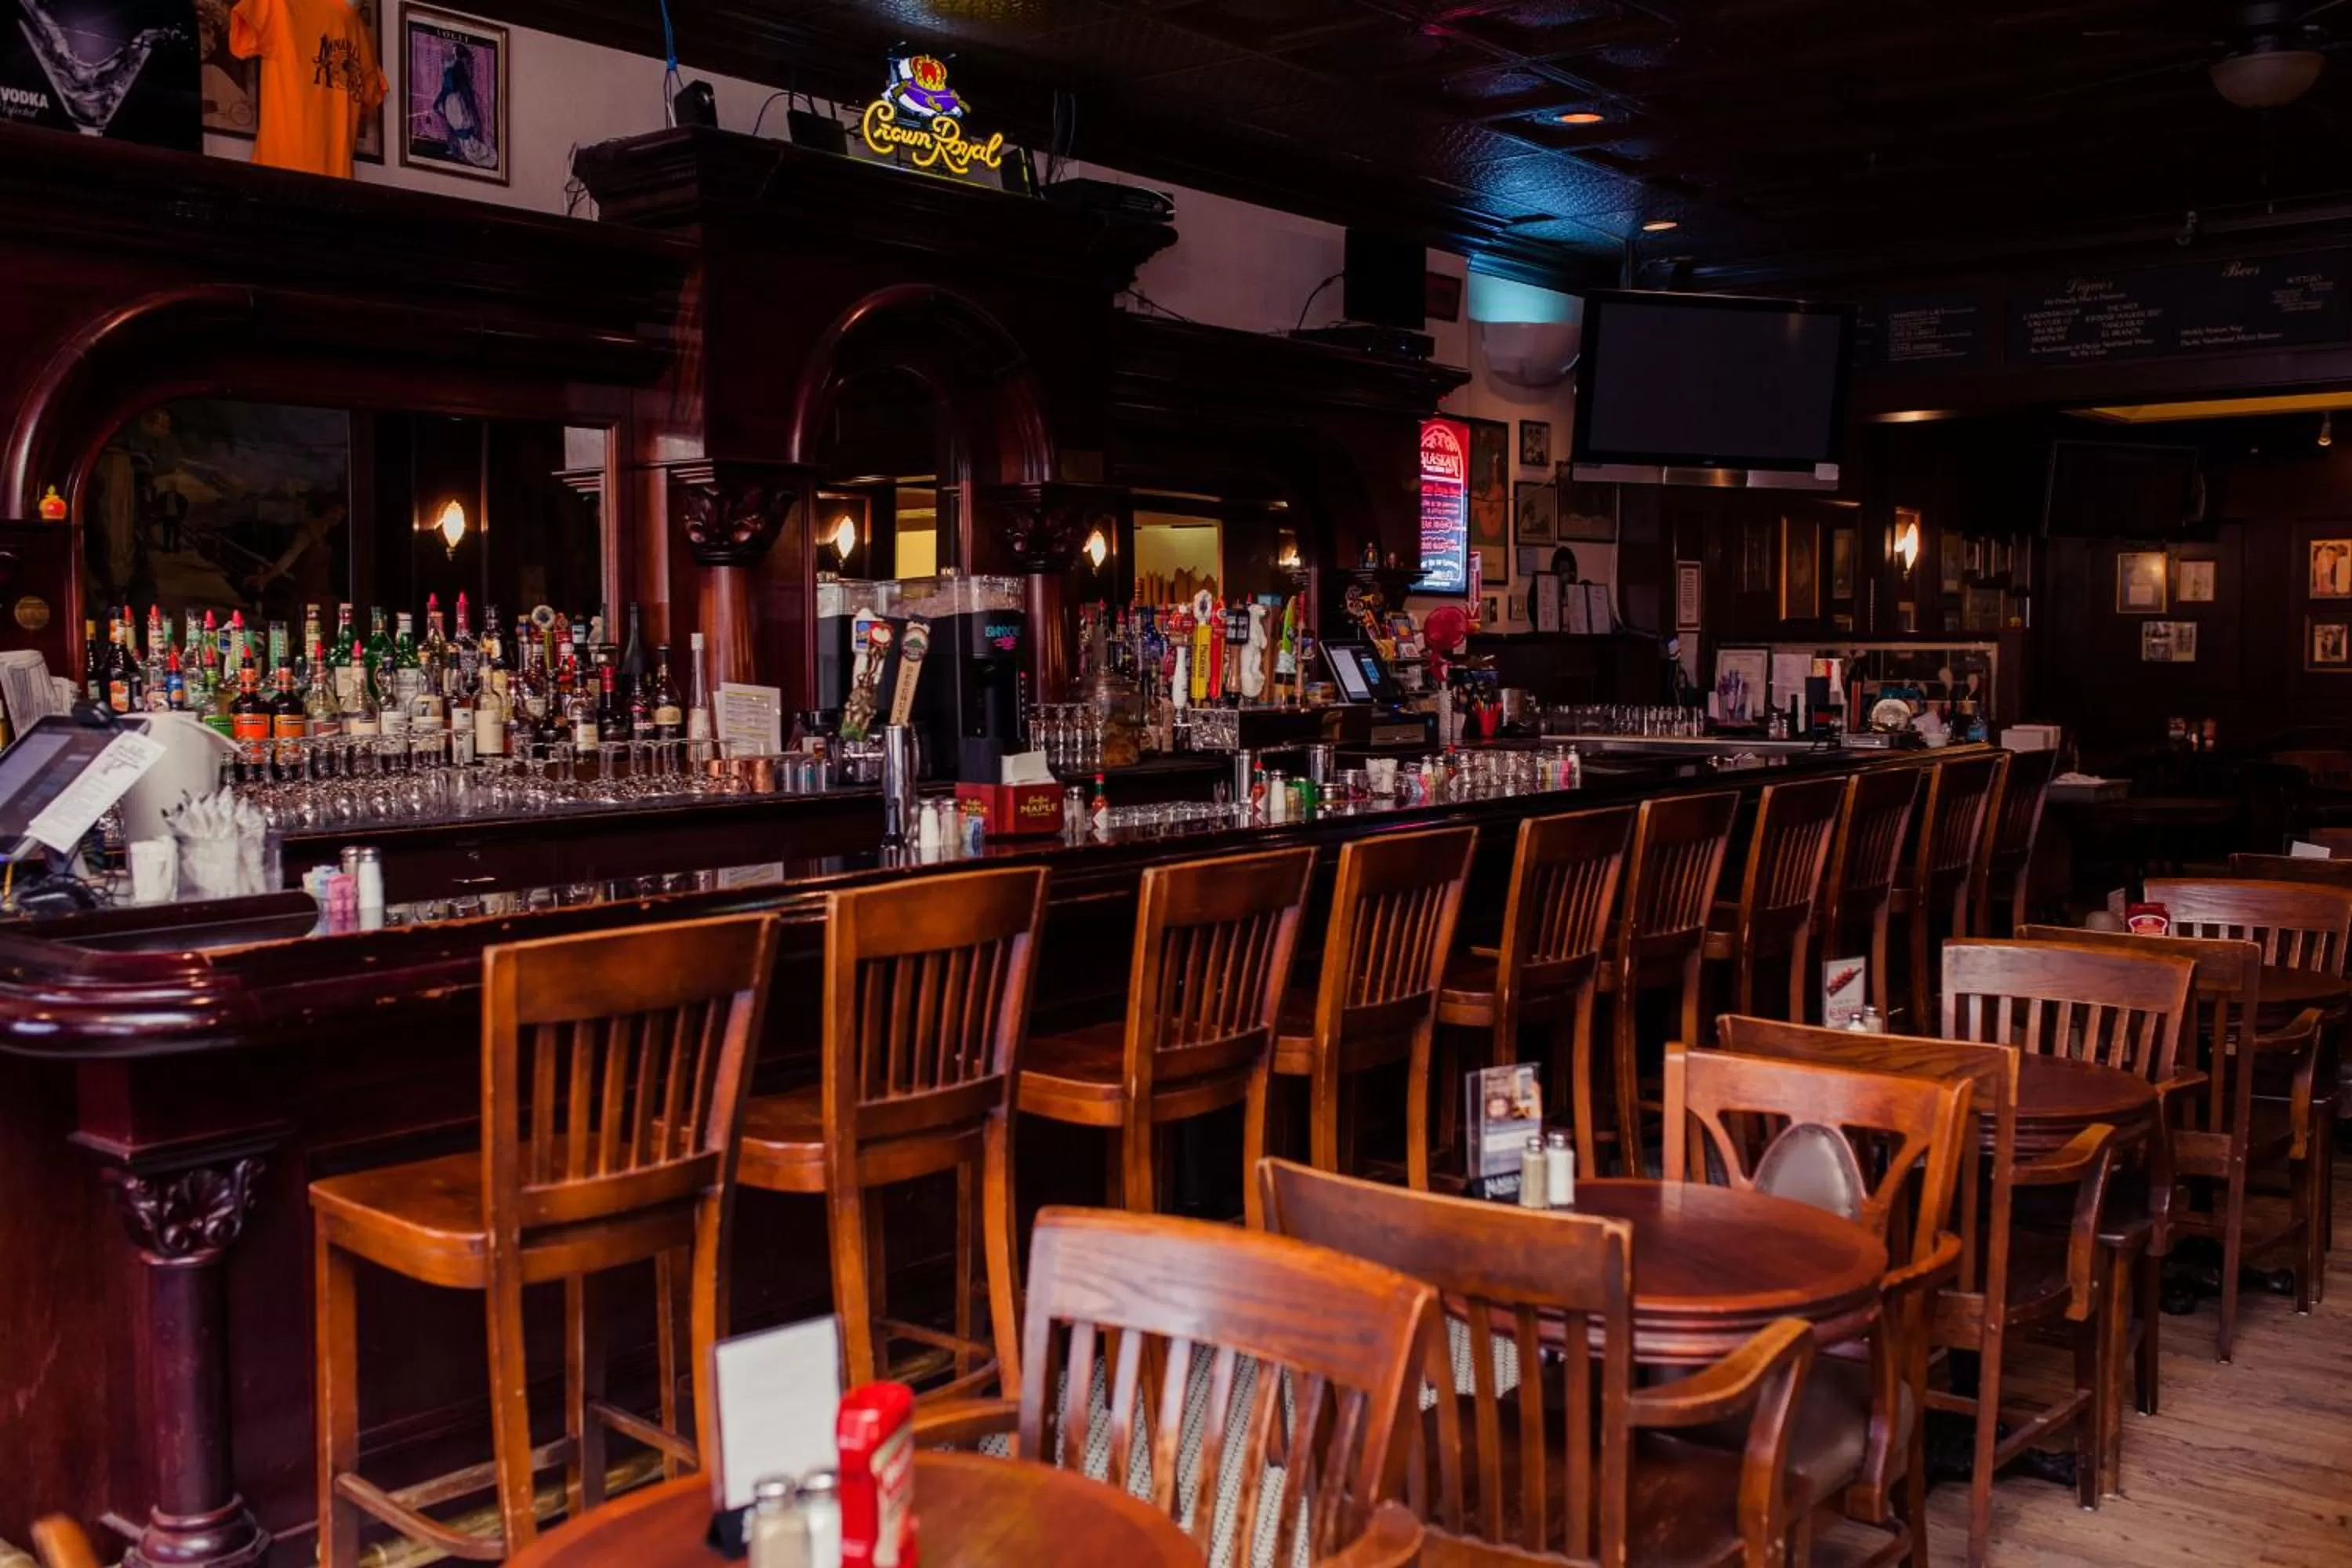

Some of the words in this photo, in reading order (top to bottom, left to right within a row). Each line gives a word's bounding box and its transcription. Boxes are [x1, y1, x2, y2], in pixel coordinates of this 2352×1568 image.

[1, 87, 49, 108] VODKA
[863, 99, 933, 154] Crown
[912, 115, 1004, 174] Royal
[1020, 801, 1057, 814] MAPLE
